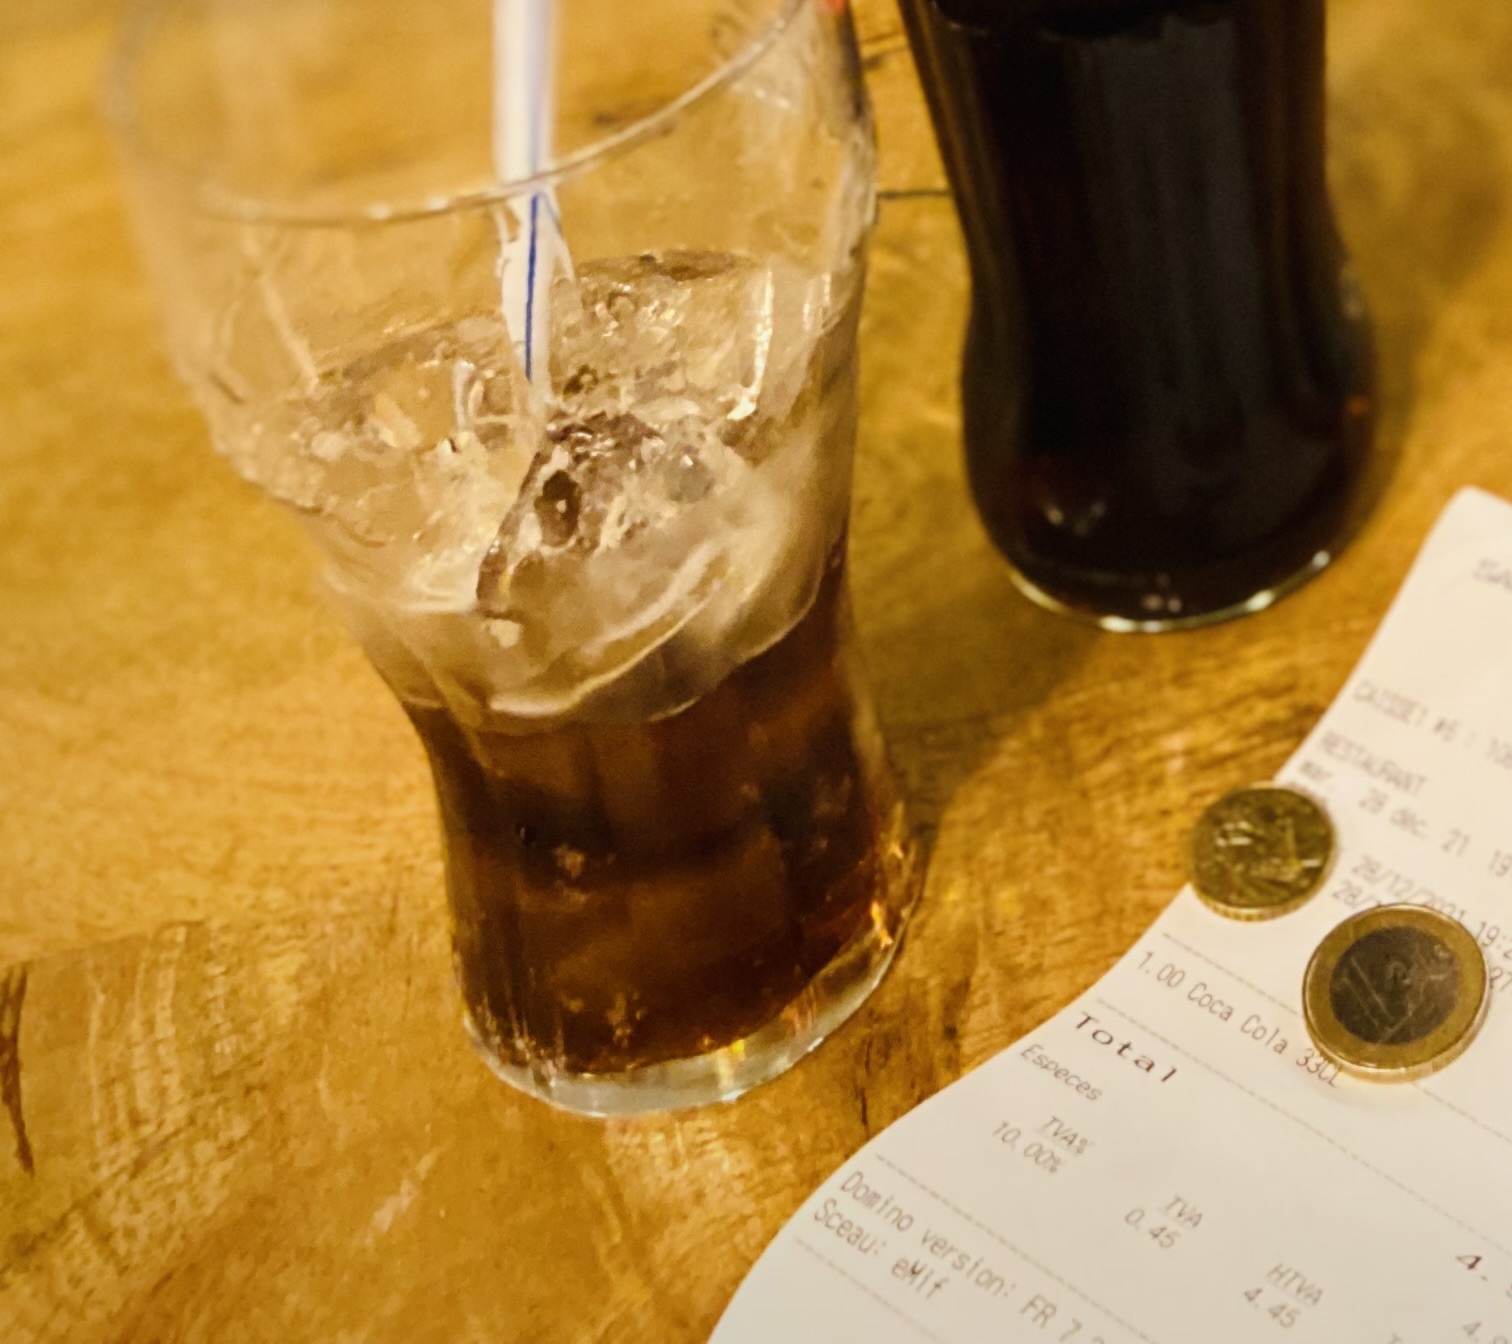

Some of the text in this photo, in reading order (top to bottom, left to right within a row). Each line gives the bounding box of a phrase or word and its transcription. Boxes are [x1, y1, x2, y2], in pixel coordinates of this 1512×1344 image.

[1441, 828, 1471, 856] 21
[1075, 1010, 1178, 1084] Total
[1188, 981, 1235, 1022] Coca
[1240, 1014, 1289, 1055] Cola
[1020, 1043, 1102, 1101] Especes
[813, 1198, 888, 1257] Sceau:
[839, 1170, 915, 1232] Domino
[921, 1226, 1017, 1300] version:
[1020, 1293, 1057, 1329] FR
[1164, 1195, 1204, 1230] TVA
[1266, 1262, 1324, 1306] HTVA
[1123, 1207, 1181, 1250] 0.45
[1243, 1286, 1300, 1329] 4.45
